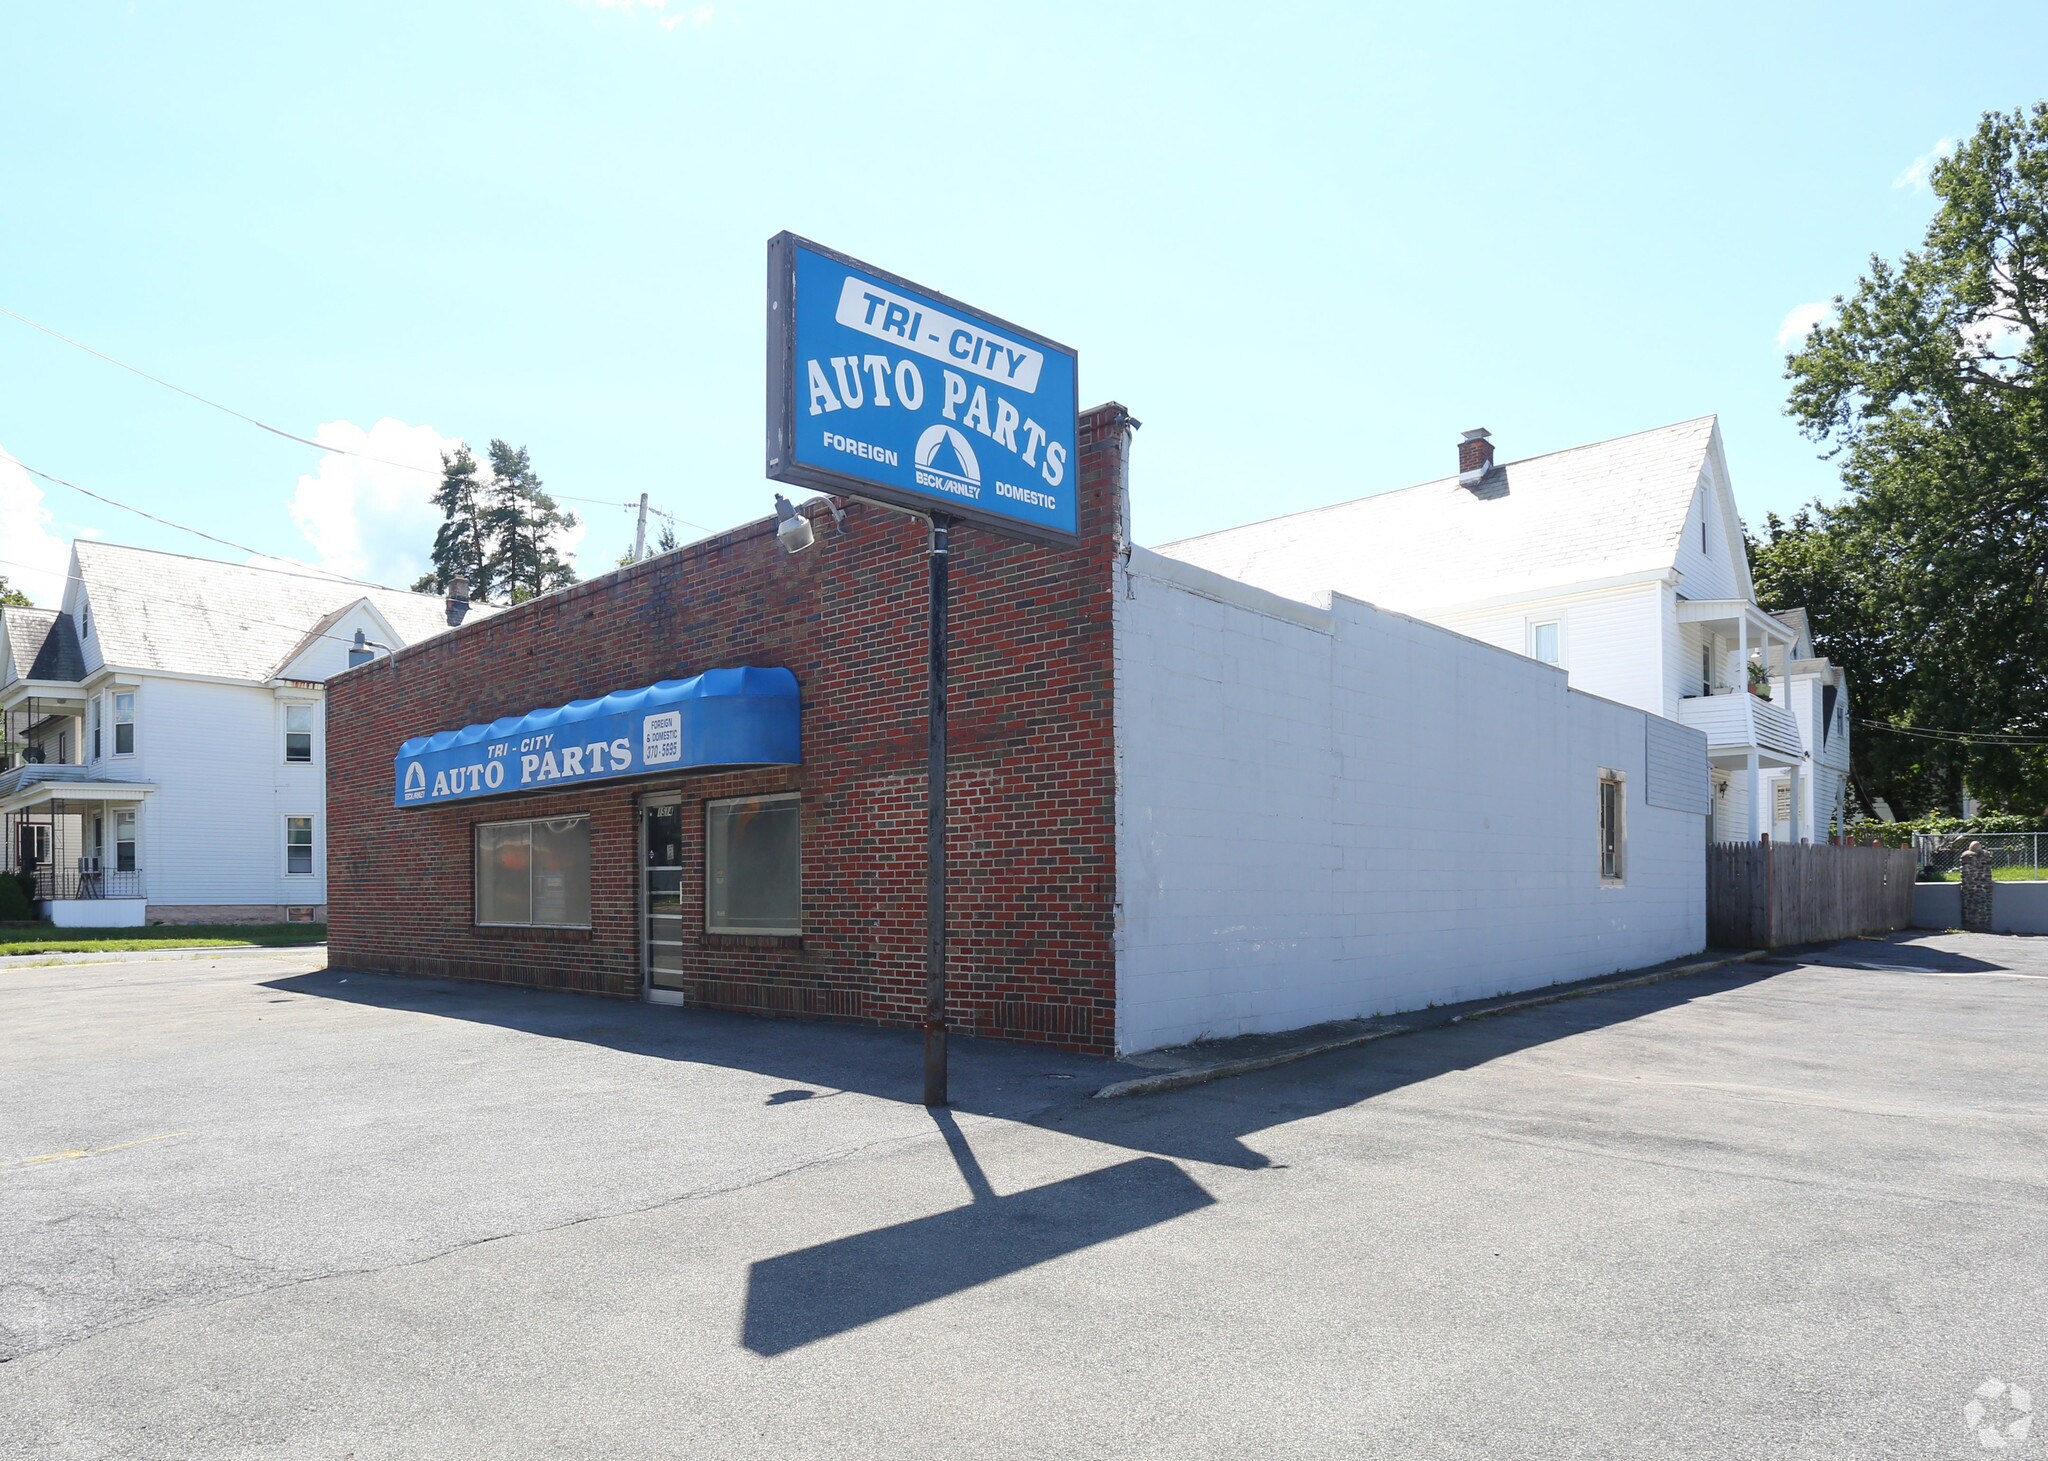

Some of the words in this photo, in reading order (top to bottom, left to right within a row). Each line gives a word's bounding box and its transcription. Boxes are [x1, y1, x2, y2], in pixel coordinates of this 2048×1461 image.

[807, 354, 924, 416] AUTO
[942, 369, 1067, 486] PARTS
[823, 431, 898, 467] FOREIGN
[995, 481, 1056, 510] DOMESTIC
[651, 717, 673, 730] FOREIGN
[652, 729, 678, 742] DOMESTIC
[431, 760, 504, 797] AUTO
[520, 737, 632, 784] PARTS
